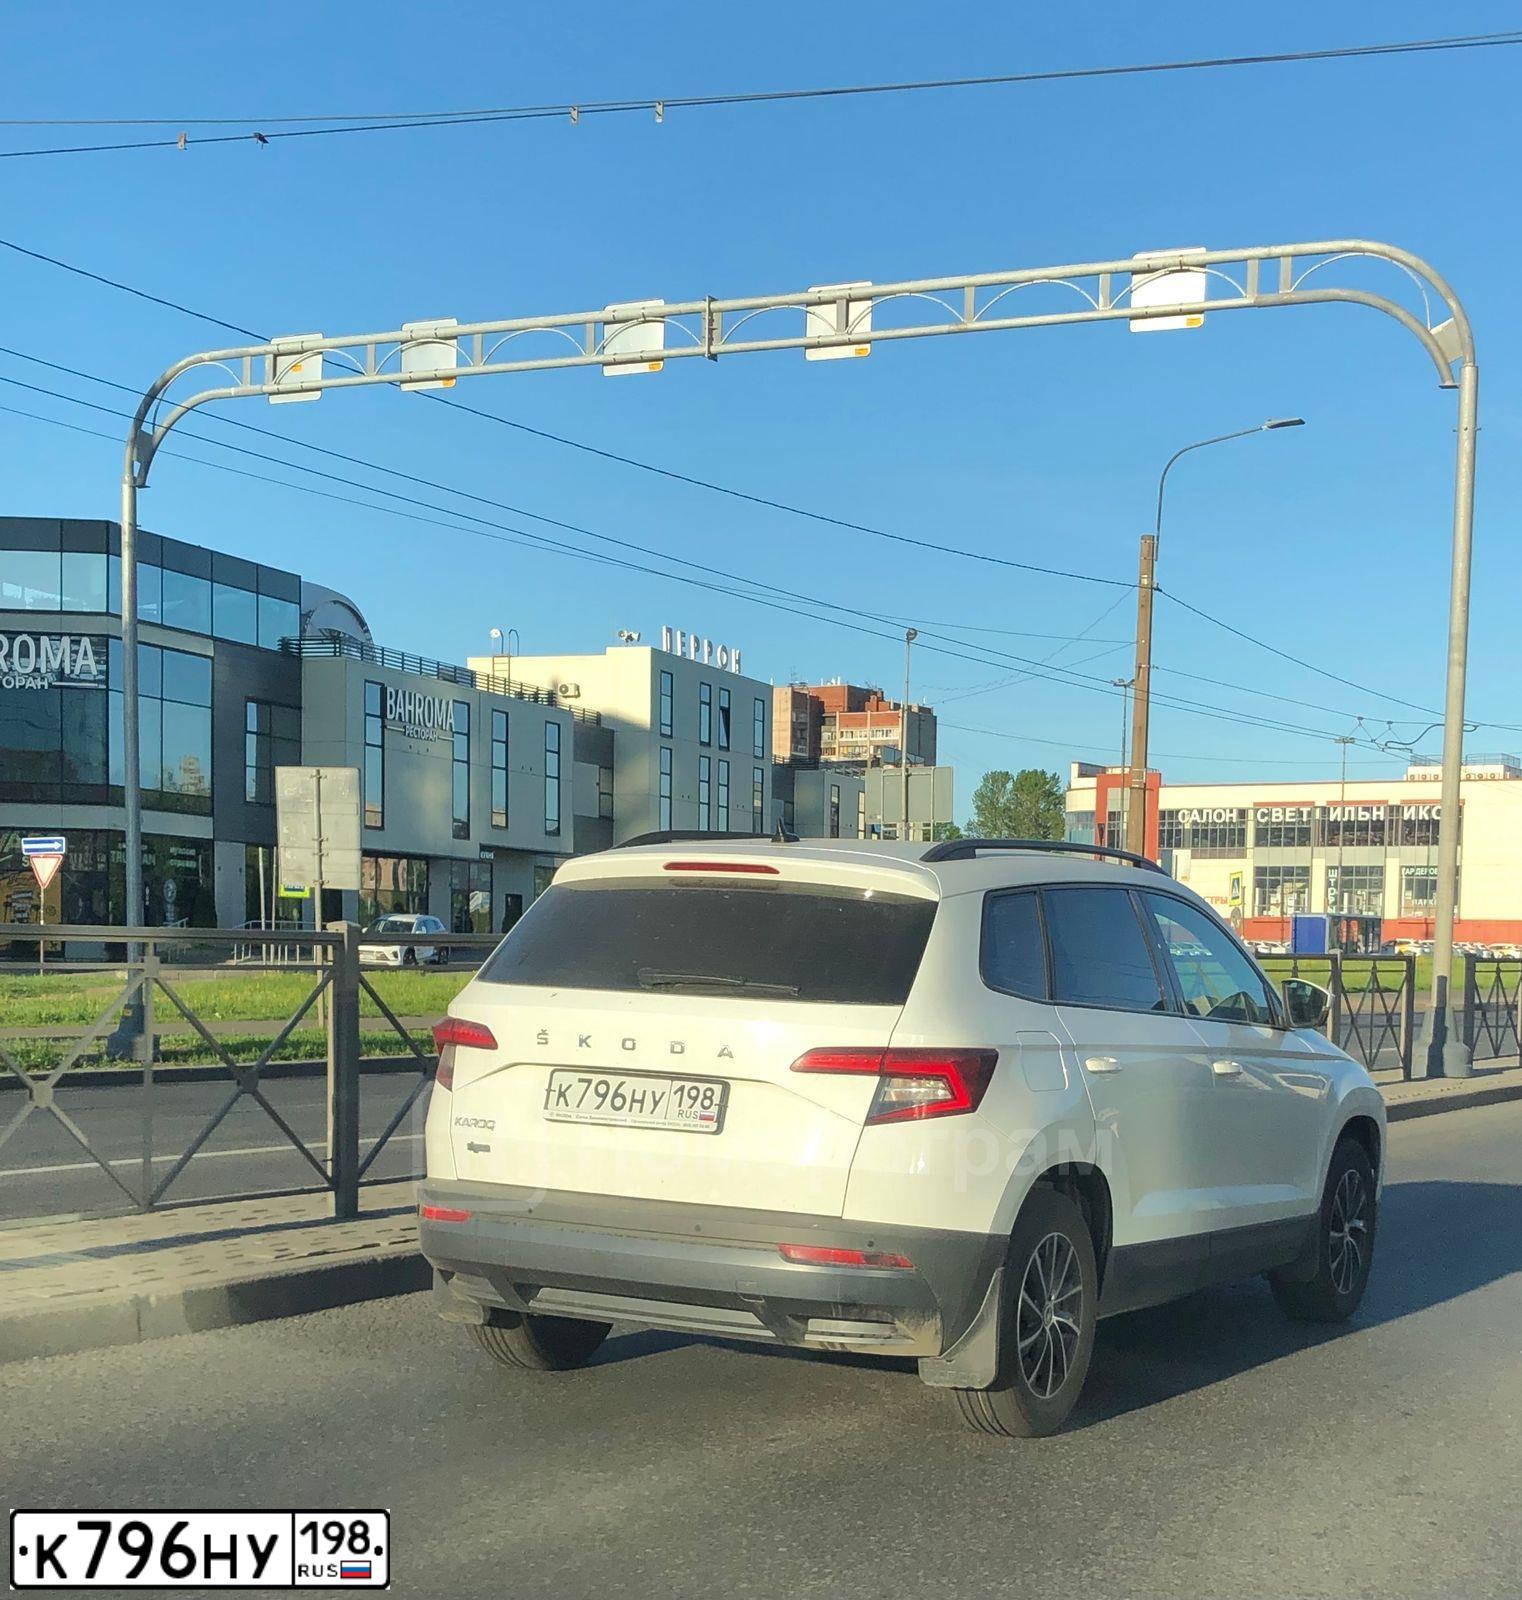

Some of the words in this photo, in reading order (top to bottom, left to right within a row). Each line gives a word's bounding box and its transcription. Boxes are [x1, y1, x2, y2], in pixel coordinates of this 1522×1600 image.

[662, 625, 742, 674] ПЕРРОН
[0, 676, 48, 690] ОРАН
[386, 686, 455, 731] BAHROMA
[405, 725, 438, 742] РЕСТОРАН
[1178, 808, 1237, 823] САЛОН
[1327, 868, 1339, 914] ШТОРЫ
[536, 1029, 734, 1059] ŠKODA
[555, 1077, 666, 1115] К796НУ
[672, 1084, 716, 1111] 198
[454, 1116, 496, 1131] KAROQ
[677, 1109, 699, 1120] RUS
